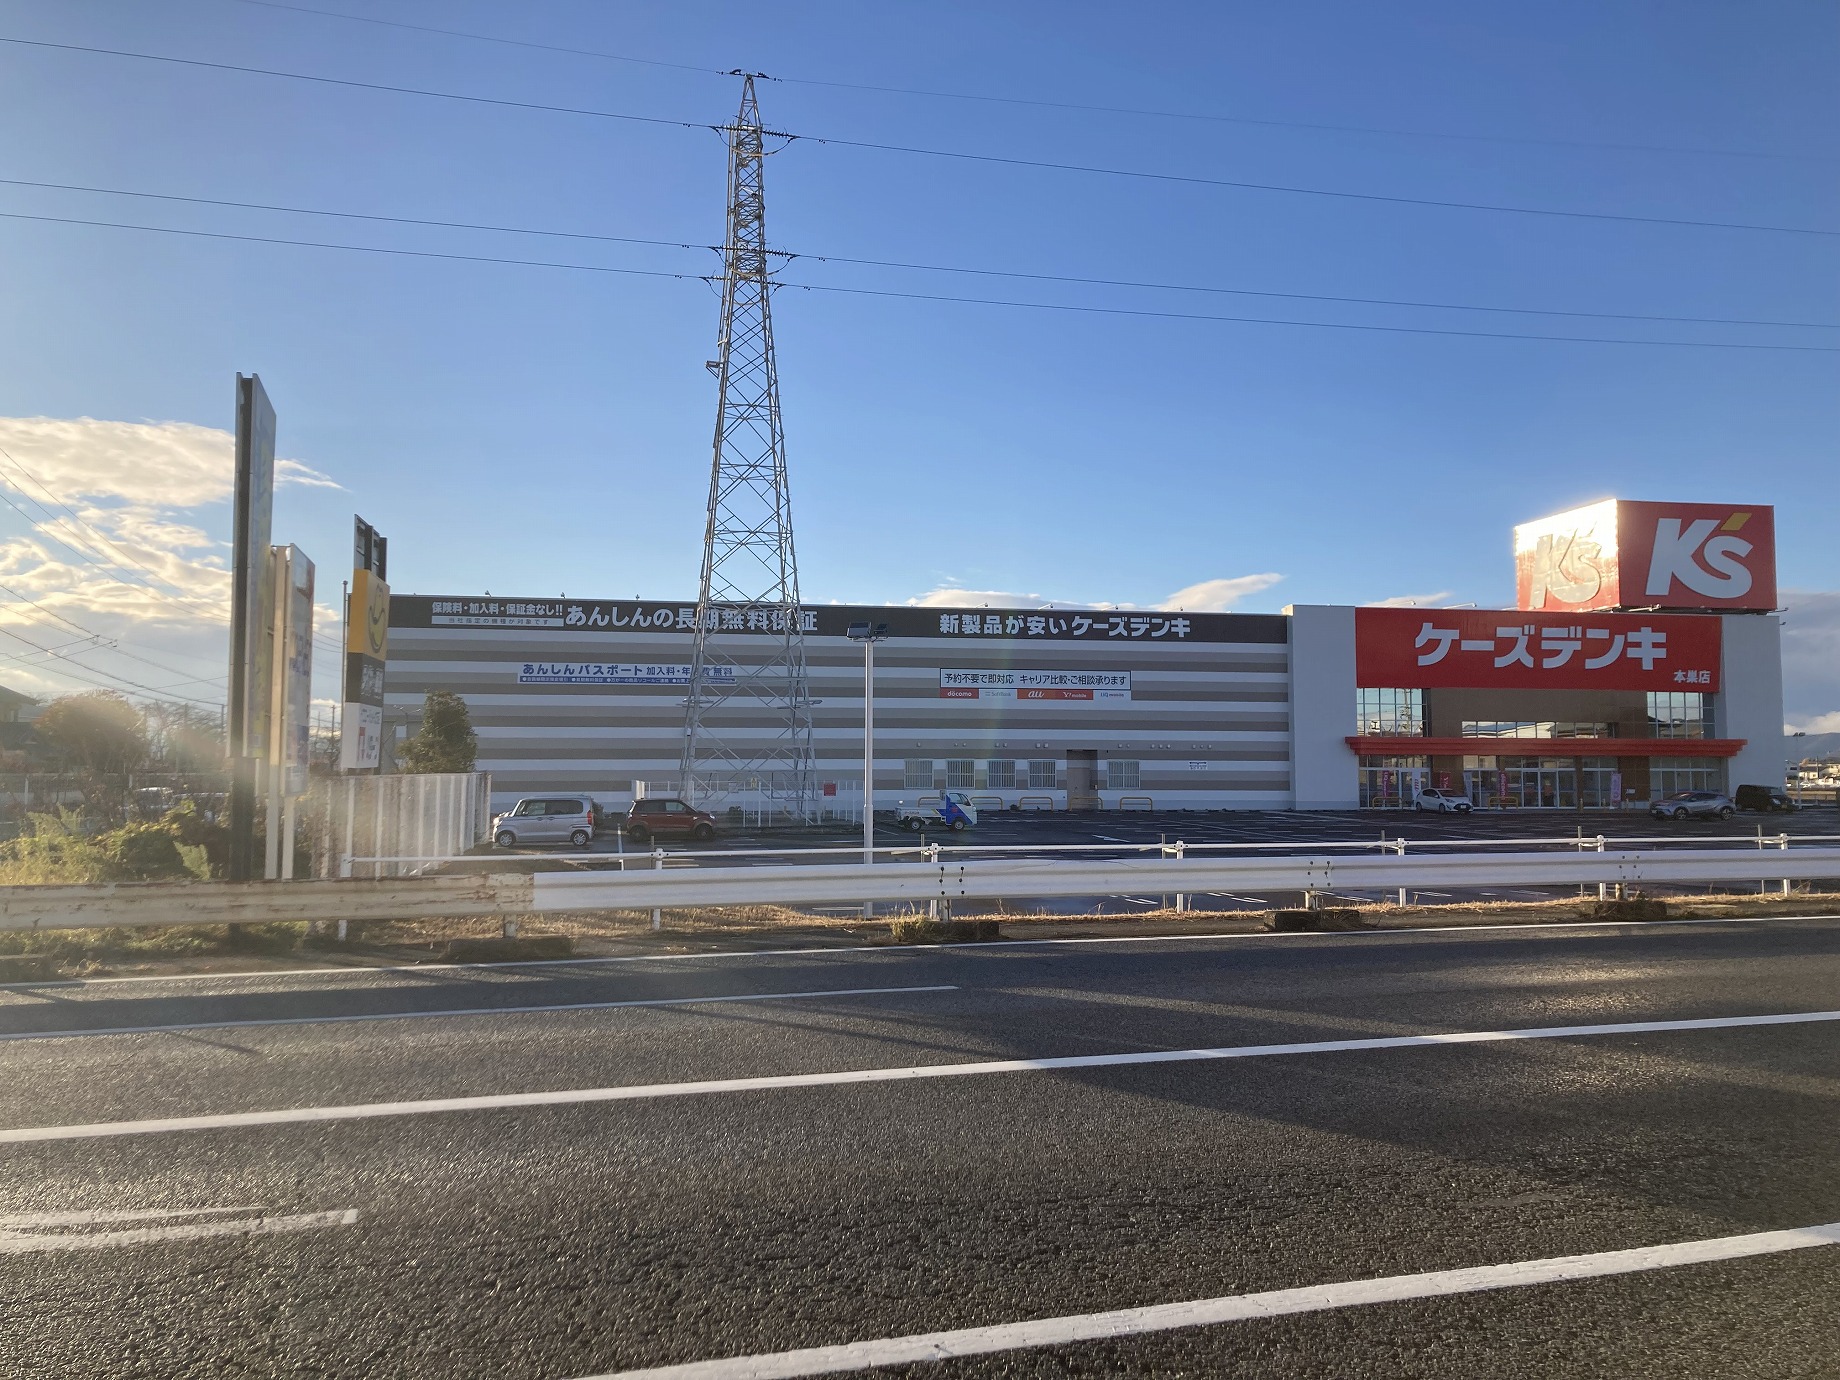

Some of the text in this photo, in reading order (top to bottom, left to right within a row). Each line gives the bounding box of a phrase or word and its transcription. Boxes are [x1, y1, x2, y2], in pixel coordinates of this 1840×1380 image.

[1414, 622, 1667, 670] ケーズデンキ
[522, 663, 643, 676] あんしんパスポート
[944, 673, 1015, 684] 予約不要で即対応
[1027, 690, 1045, 698] au
